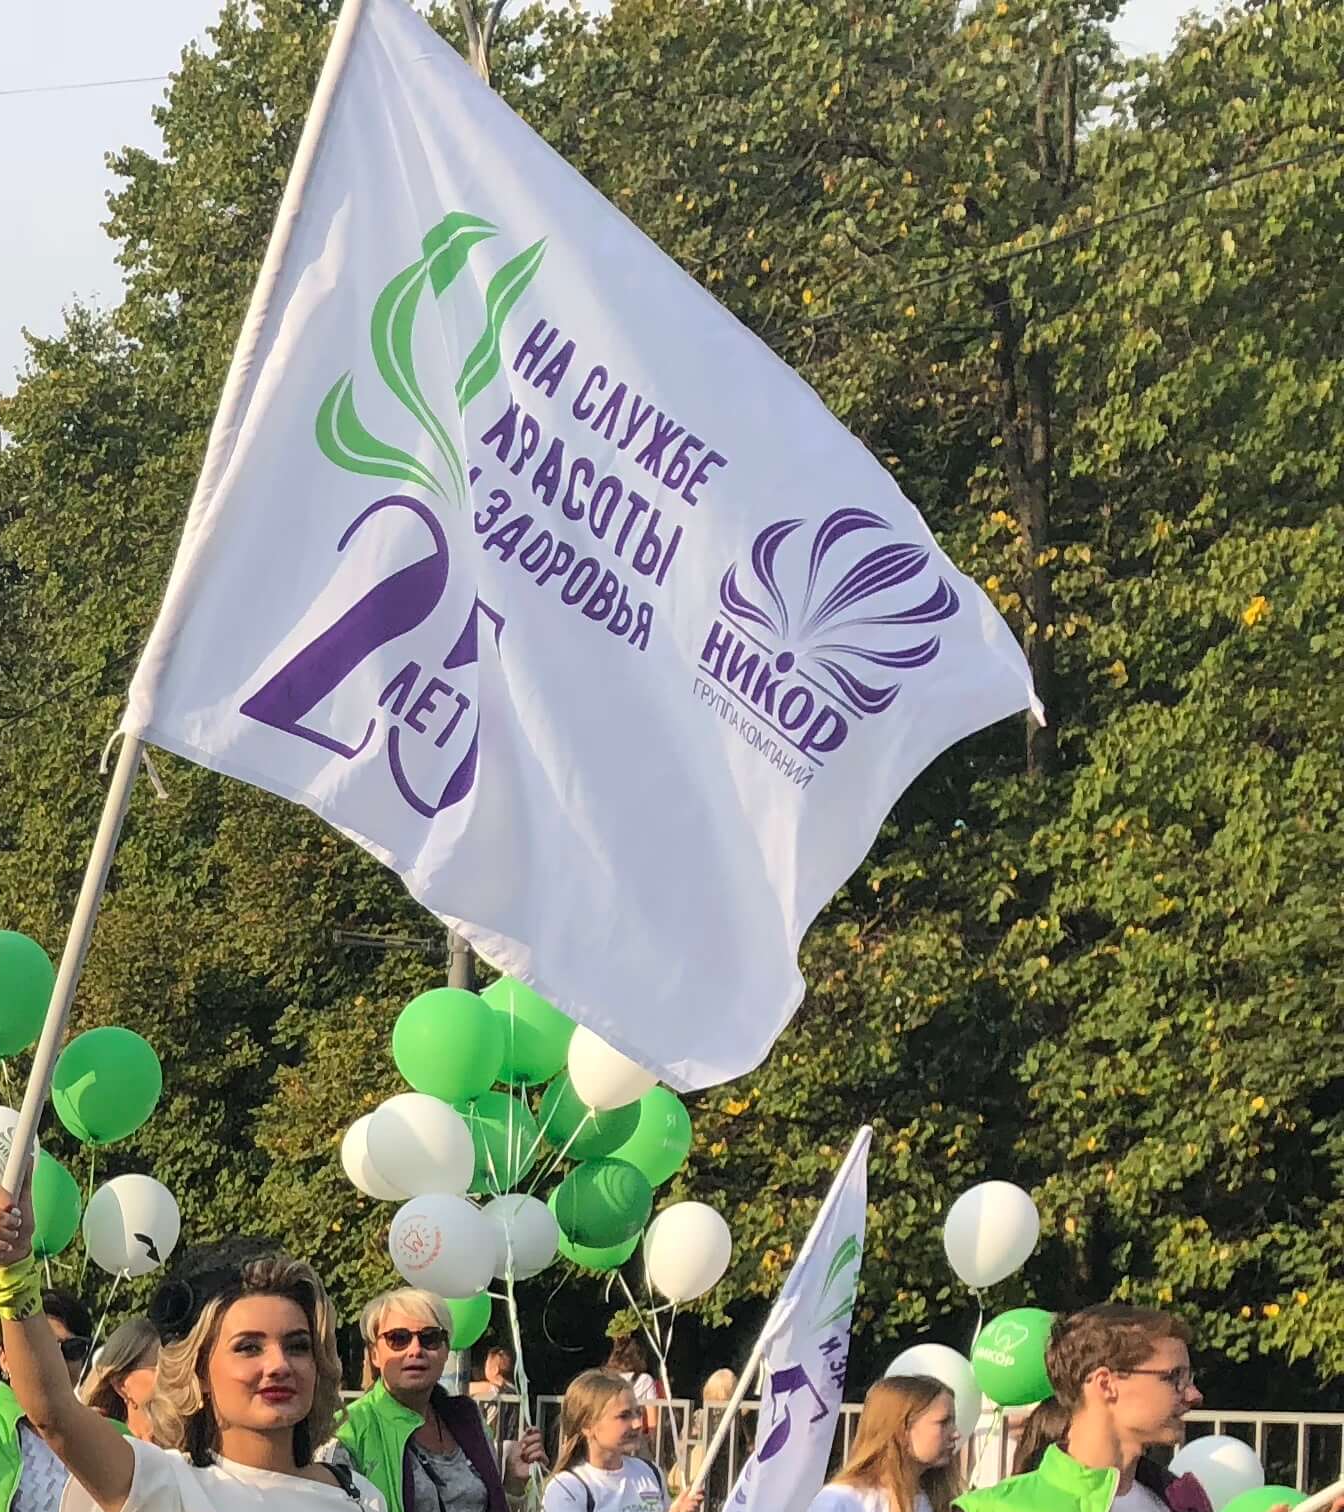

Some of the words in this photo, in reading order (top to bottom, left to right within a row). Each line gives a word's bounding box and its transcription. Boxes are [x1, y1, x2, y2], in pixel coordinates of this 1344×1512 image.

[513, 318, 562, 399] НА
[570, 366, 728, 507] СЛУЖБЕ
[473, 488, 655, 652] ЗДОРОВЬЯ
[378, 660, 471, 750] ЛЕТ
[693, 677, 740, 731] ГРУППА
[739, 718, 815, 791] КОМПАНИЙ
[701, 620, 849, 752] НИКОР
